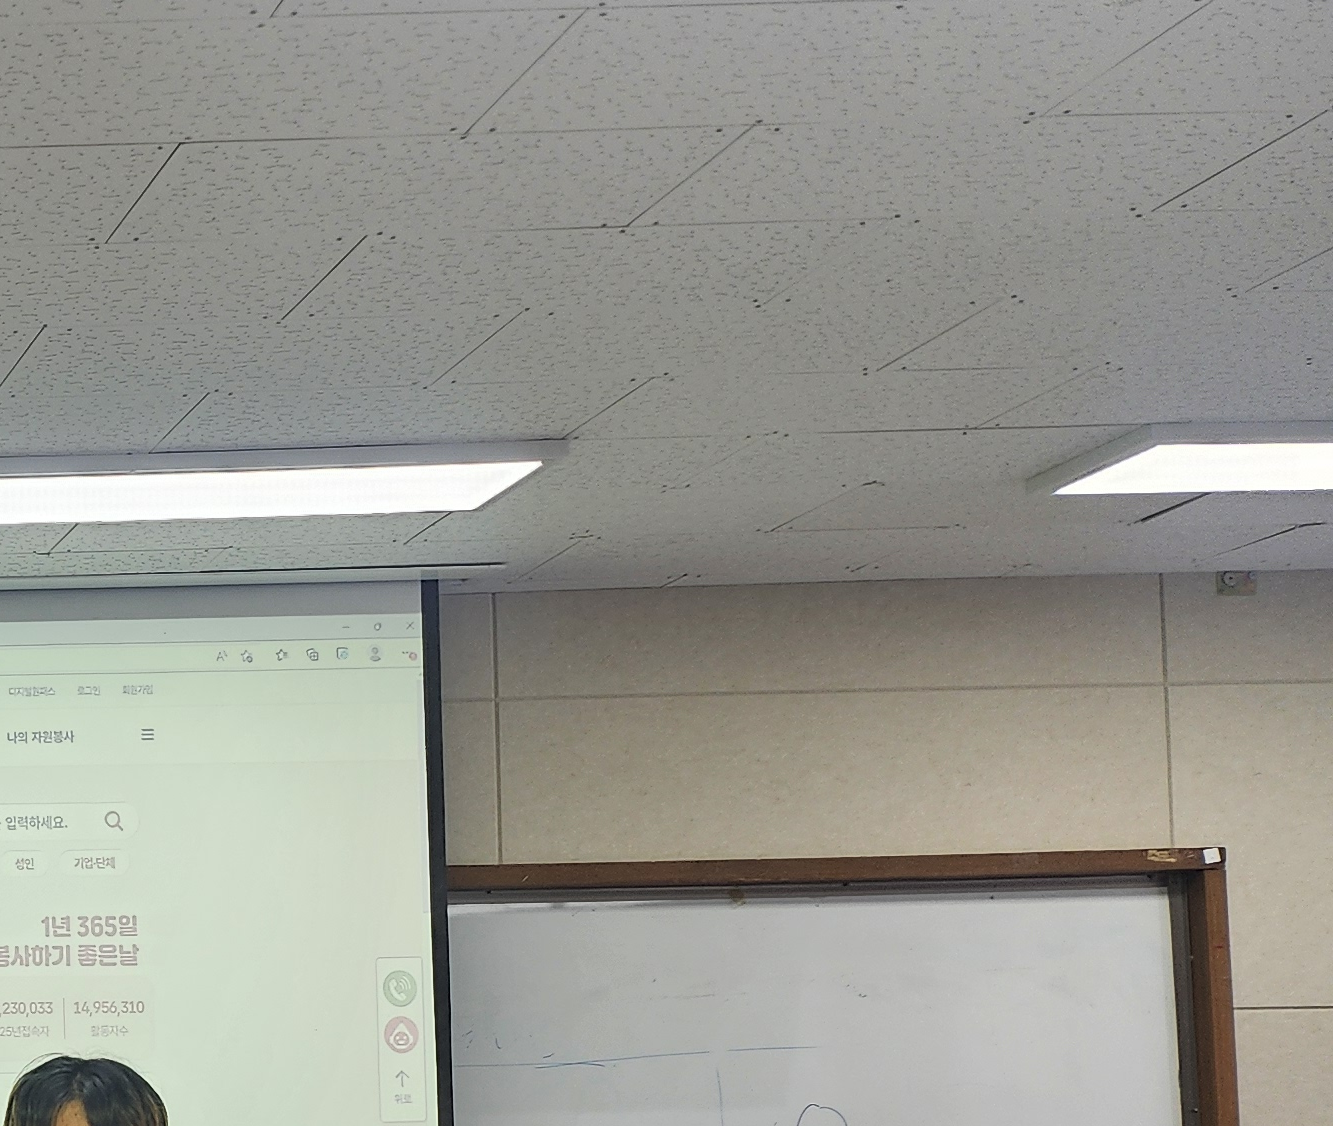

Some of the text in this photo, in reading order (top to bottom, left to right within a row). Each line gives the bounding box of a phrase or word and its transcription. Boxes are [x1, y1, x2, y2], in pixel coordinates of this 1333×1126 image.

[6, 730, 75, 744] 나의 자원봉사
[4, 815, 69, 831] 입력하세요.
[15, 857, 35, 870] 성인
[41, 914, 139, 938] 1년 365일
[77, 943, 140, 967] 좋은날
[73, 1000, 145, 1017] 14,956,310
